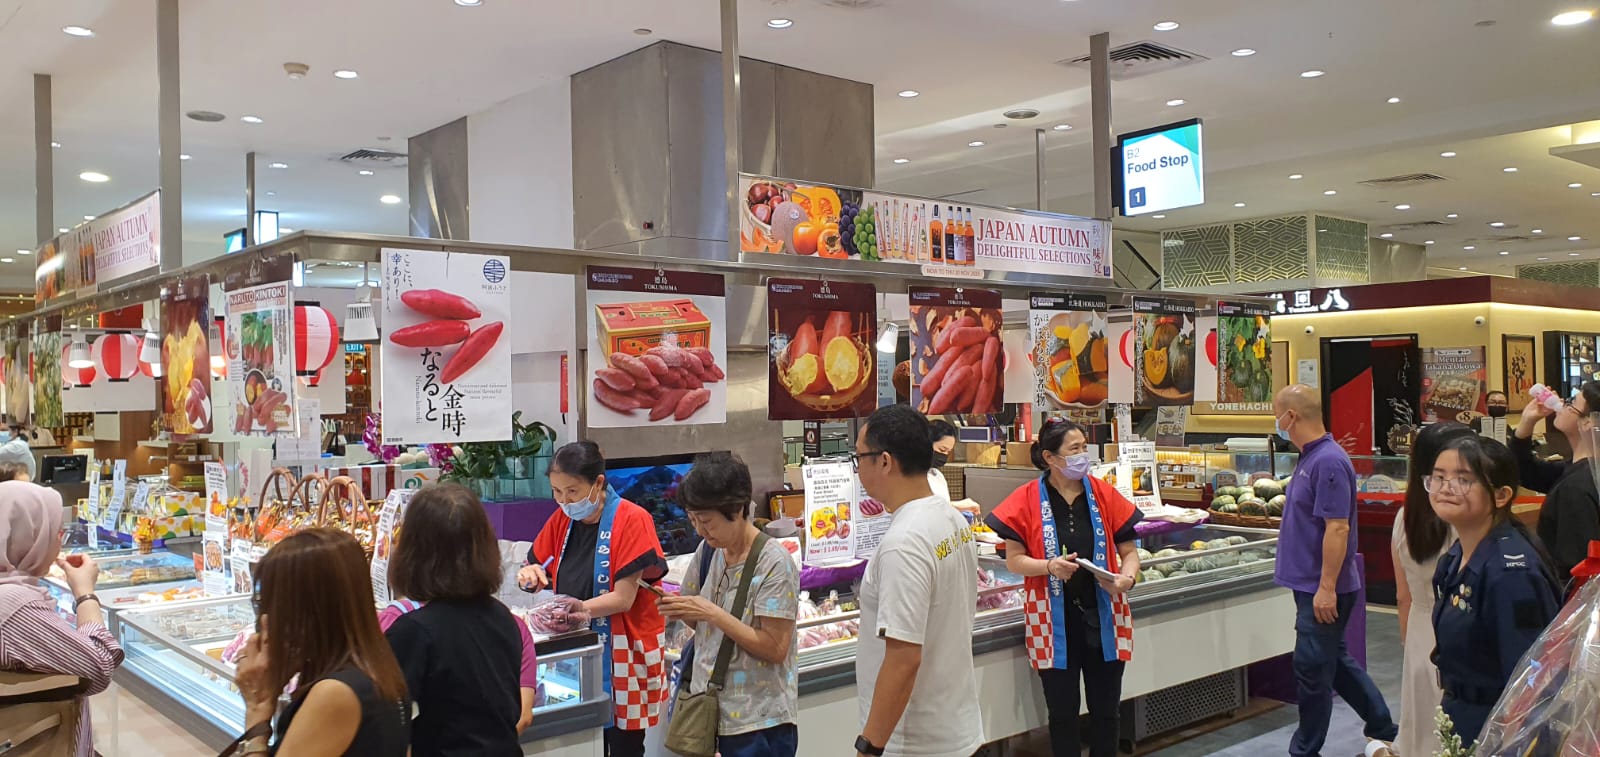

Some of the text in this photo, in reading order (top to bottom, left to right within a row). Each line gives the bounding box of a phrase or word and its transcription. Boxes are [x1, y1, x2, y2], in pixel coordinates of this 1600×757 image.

[1127, 148, 1140, 159] B2
[1127, 155, 1189, 174] Food Stop
[1134, 191, 1141, 203] 1
[94, 226, 116, 257] JAPAN
[117, 212, 149, 243] AUTUMN
[976, 218, 1090, 249] JAPAN AUTUMN
[976, 243, 1091, 265] DELIGHTFUL SELECTIONS
[230, 285, 286, 304] NARUTO KINTOKI
[644, 283, 677, 291] TOKUSHIMA
[345, 343, 359, 351] EXIT
[420, 347, 442, 422] なると
[440, 384, 466, 437] 金時
[1209, 402, 1273, 411] YONEHACHI
